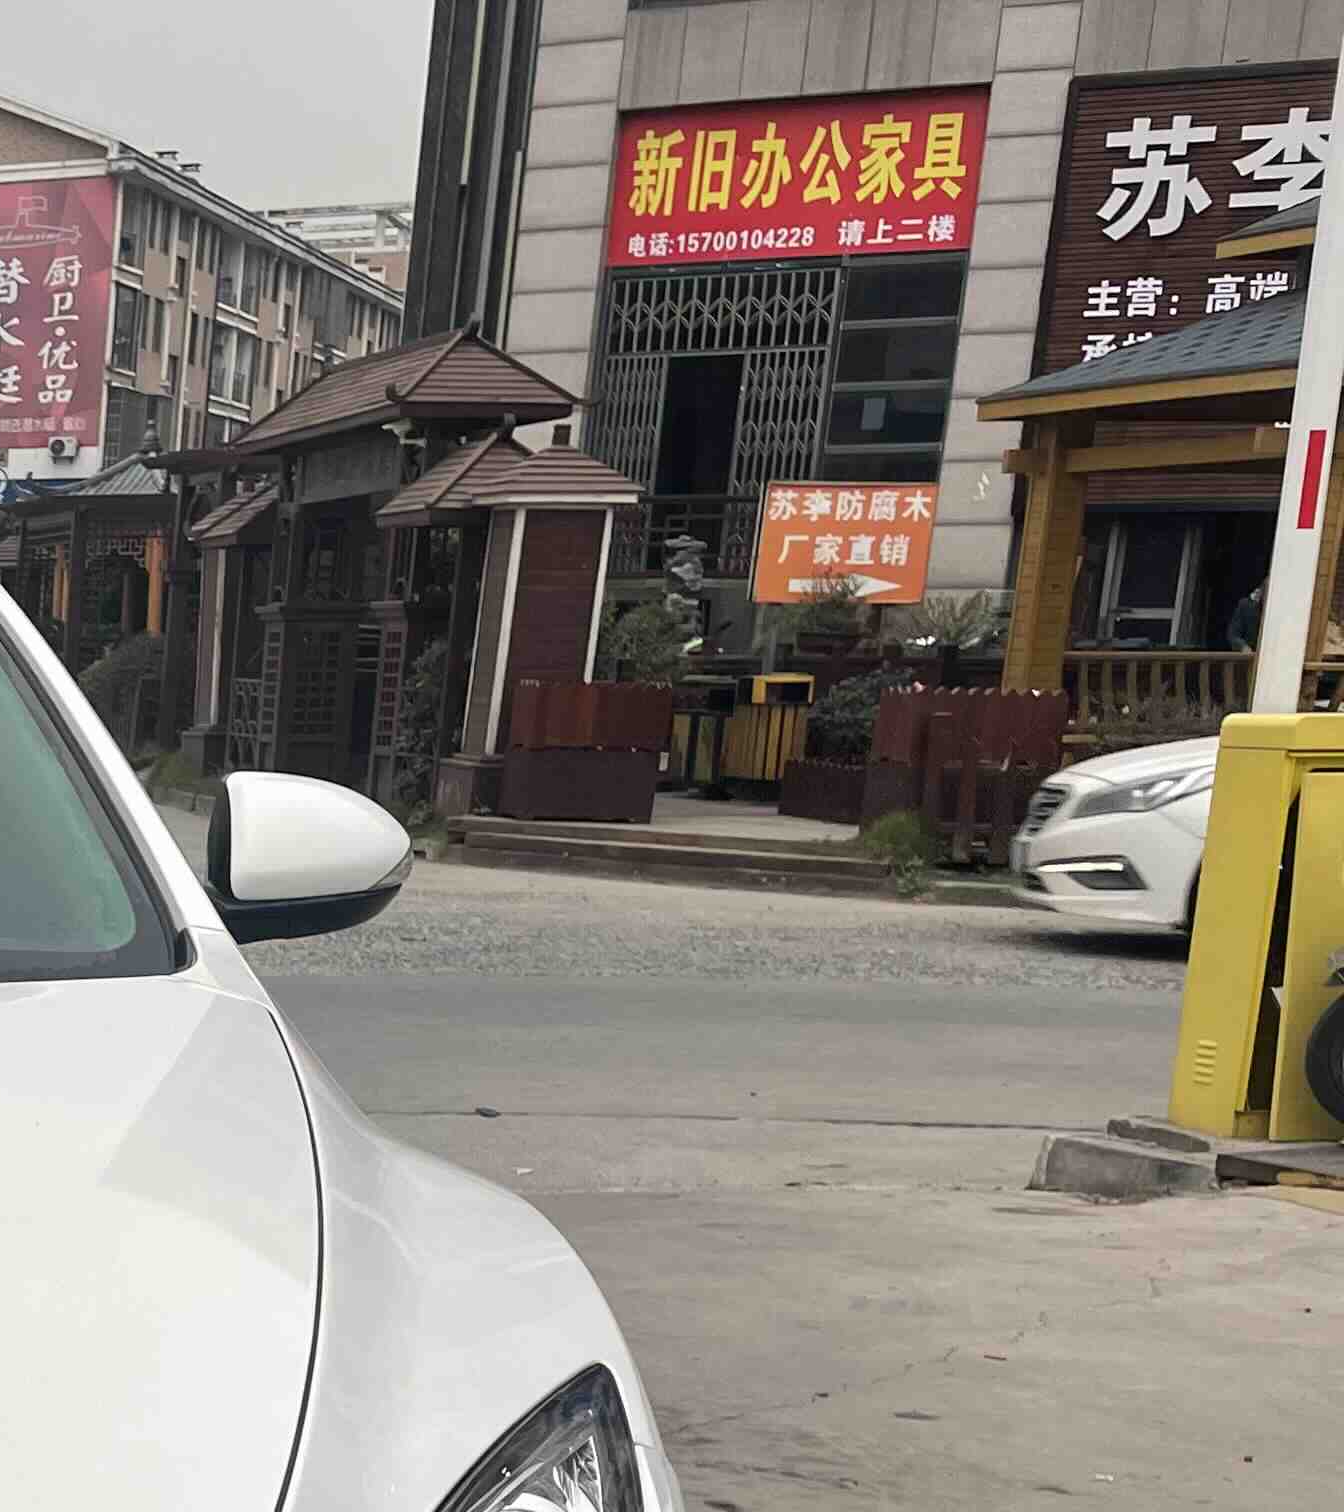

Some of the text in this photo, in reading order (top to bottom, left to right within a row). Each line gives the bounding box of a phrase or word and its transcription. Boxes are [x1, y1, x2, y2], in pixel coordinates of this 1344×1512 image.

[628, 112, 967, 217] 新旧办公家具
[628, 214, 956, 257] 电话:15700104228 请上二楼
[768, 489, 932, 523] 苏李防腐木
[777, 533, 912, 567] 厂家直销
